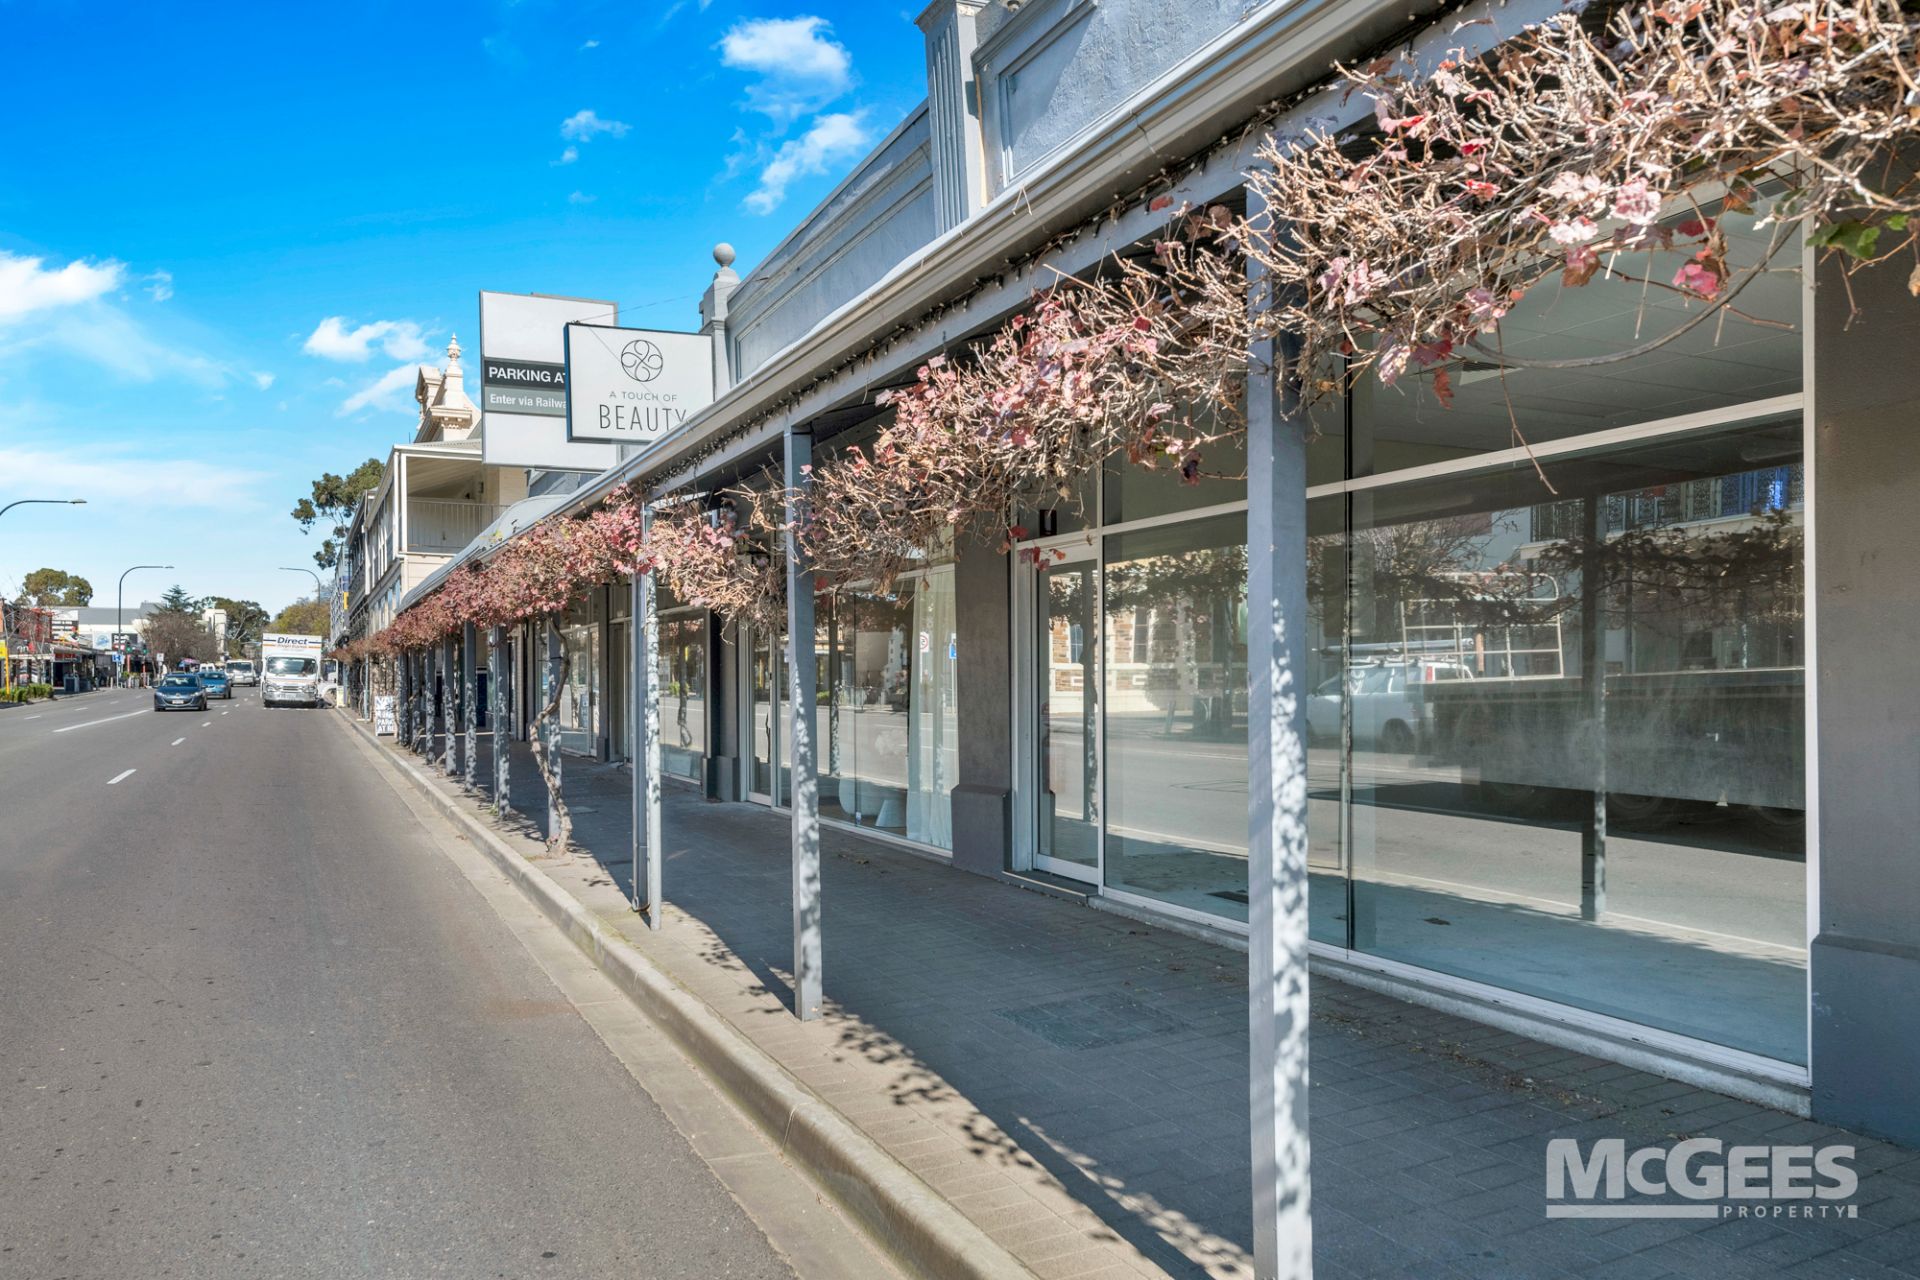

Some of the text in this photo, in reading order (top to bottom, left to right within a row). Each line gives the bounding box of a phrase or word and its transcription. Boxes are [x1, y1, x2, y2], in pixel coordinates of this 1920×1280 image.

[488, 366, 551, 383] PARKING
[489, 393, 517, 405] Enter
[518, 396, 533, 406] via
[609, 391, 678, 402] A TOUCH OF
[276, 636, 308, 645] Direct
